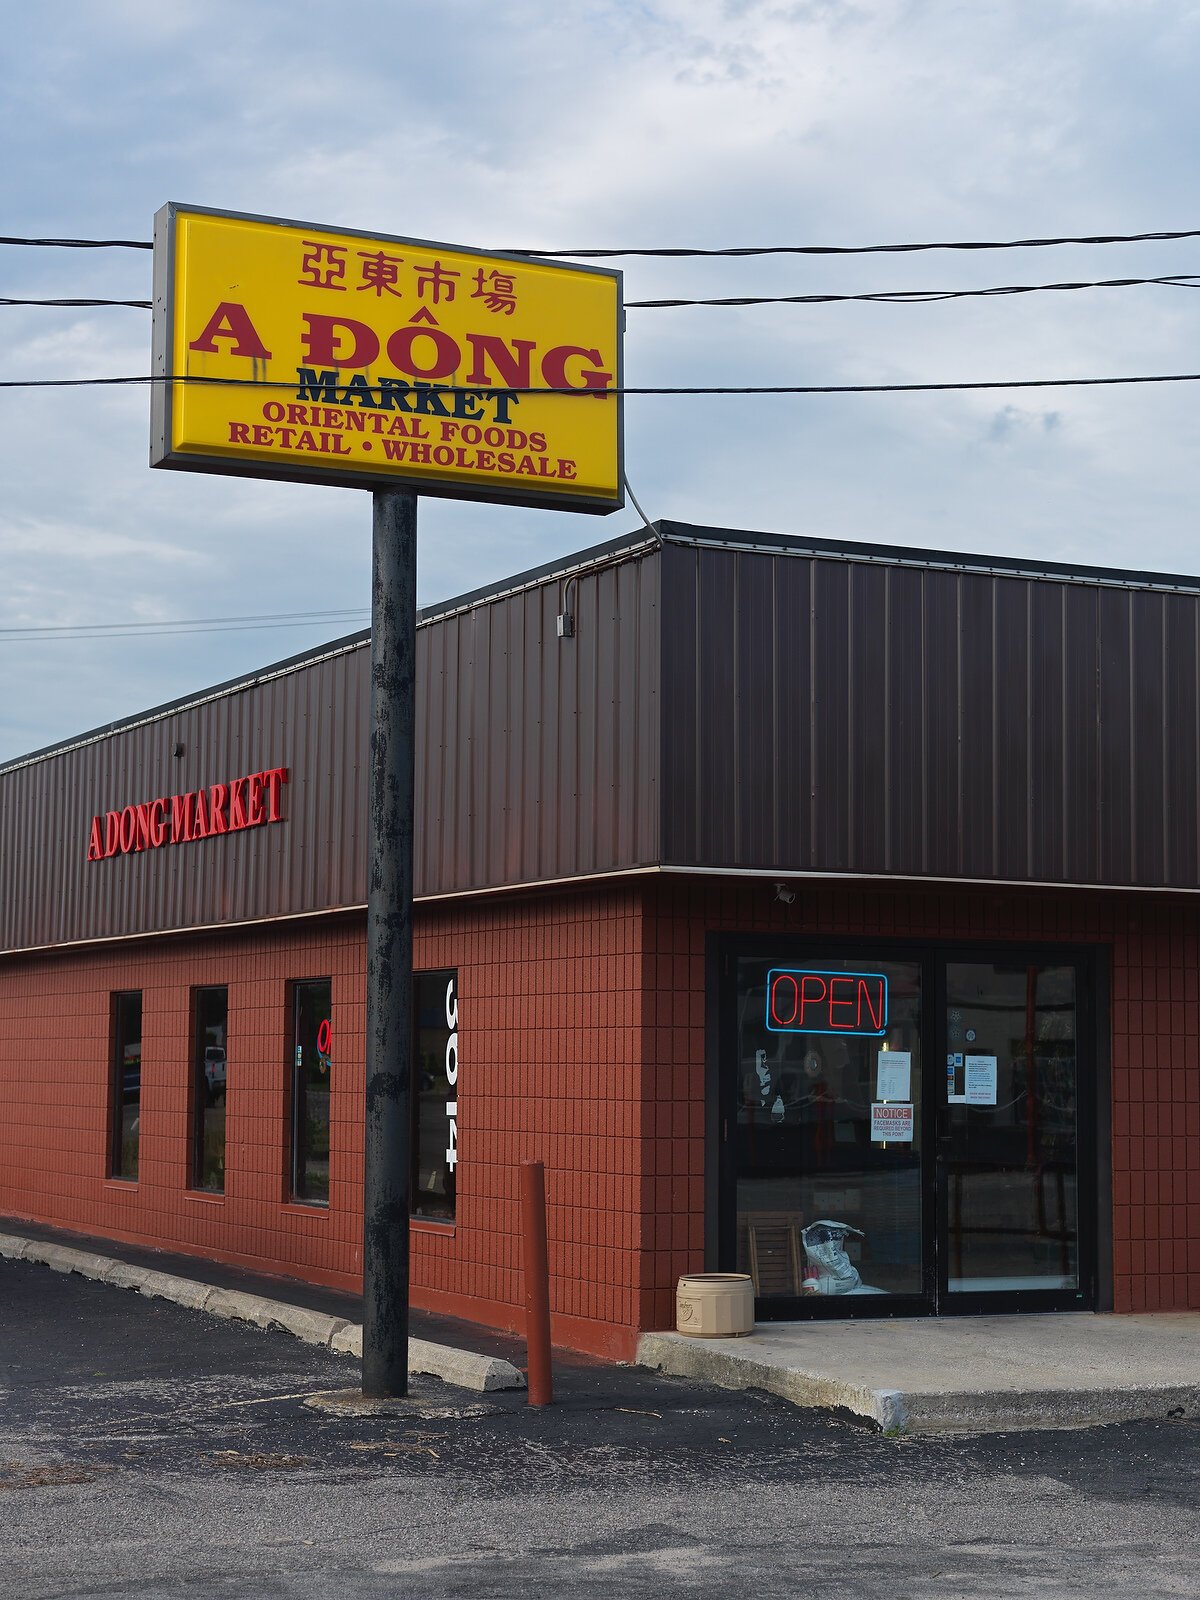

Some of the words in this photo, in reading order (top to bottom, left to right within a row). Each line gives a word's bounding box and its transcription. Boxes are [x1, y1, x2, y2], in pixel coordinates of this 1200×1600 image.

[189, 302, 272, 360] A
[301, 306, 613, 400] ĐÔNG
[296, 367, 520, 424] MARKET
[228, 421, 352, 456] RETAIL
[383, 440, 577, 480] WHOLESALE
[262, 401, 430, 439] ORIENTAL
[440, 422, 548, 453] FOODS
[87, 815, 105, 861] A
[104, 797, 171, 854] DONG
[169, 767, 289, 844] MARKET
[771, 975, 884, 1030] OPEN
[876, 1108, 908, 1119] NOTICE
